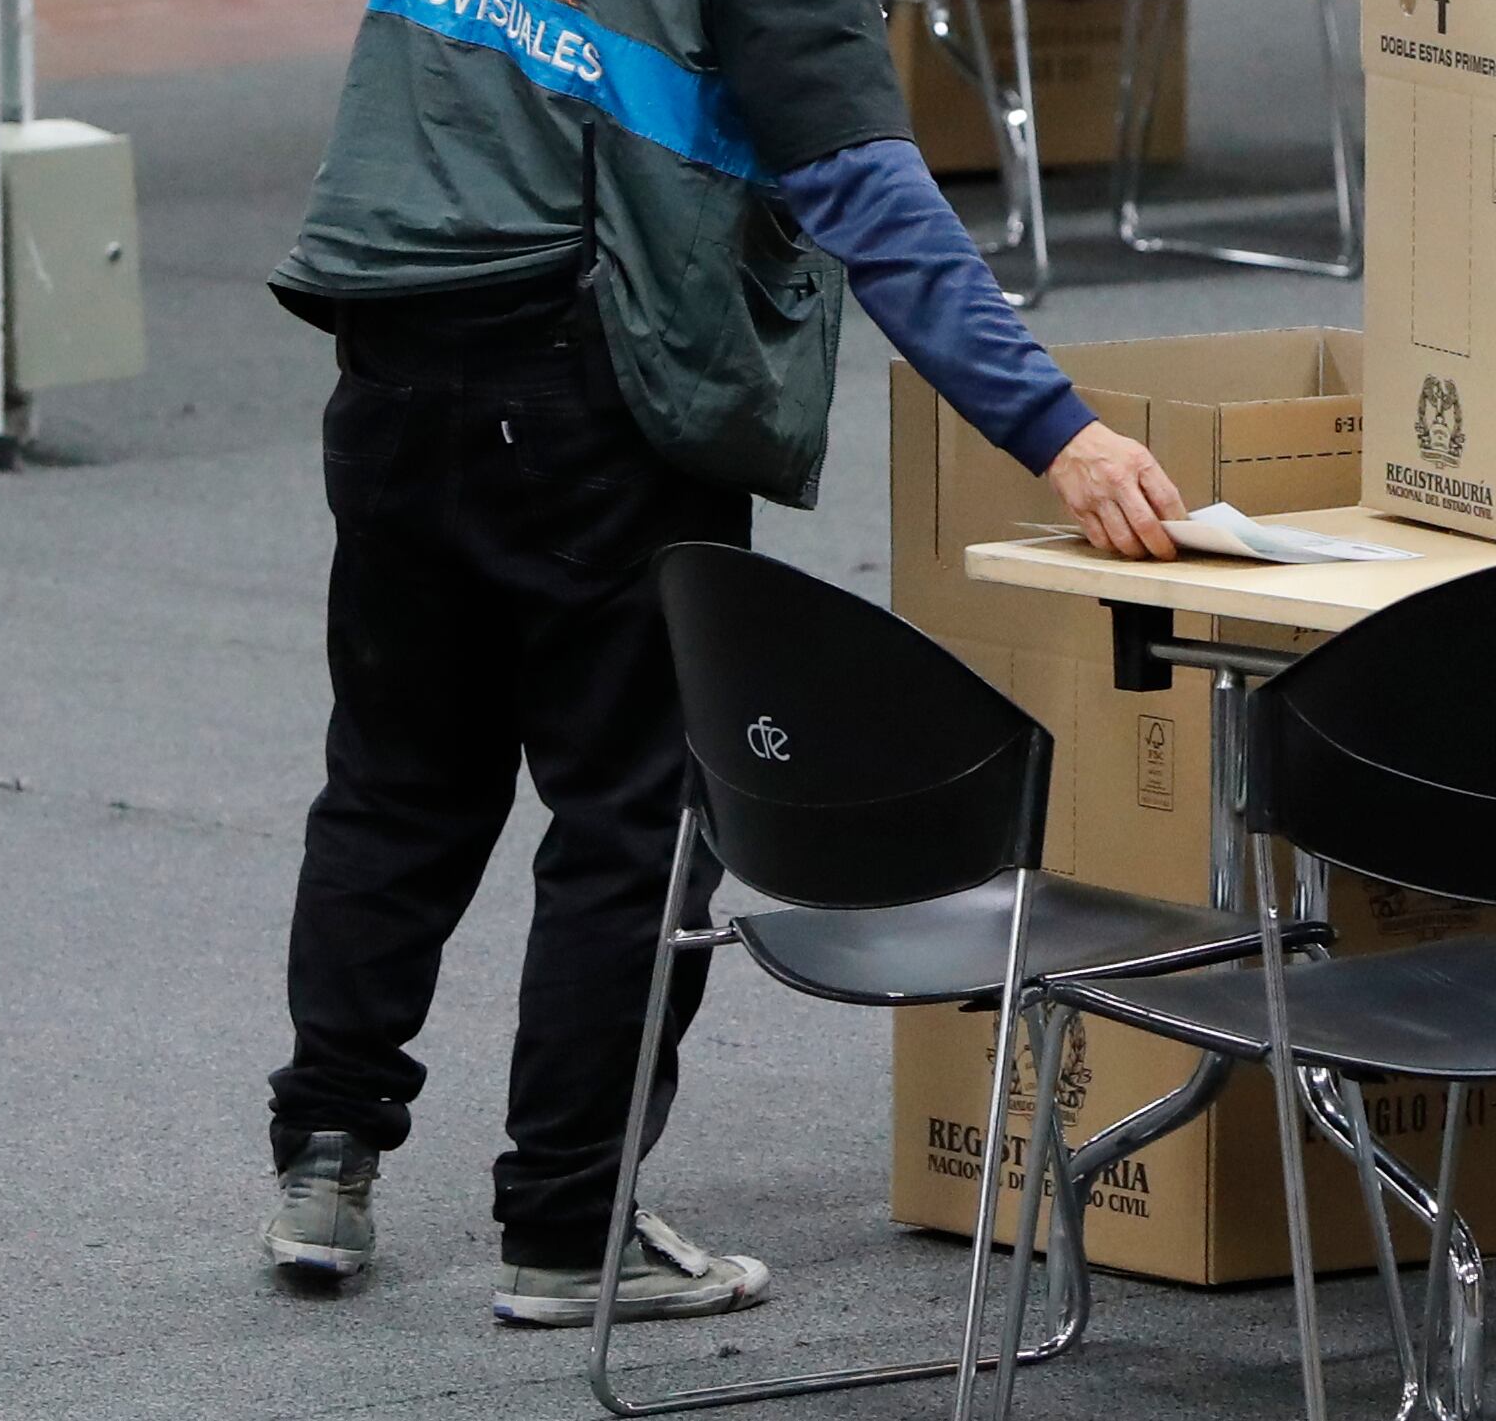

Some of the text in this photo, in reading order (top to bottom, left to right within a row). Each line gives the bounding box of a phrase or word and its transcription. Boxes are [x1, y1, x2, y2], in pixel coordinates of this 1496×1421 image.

[1381, 35, 1416, 59] DOBLE
[1419, 43, 1452, 67] ESTAS
[1335, 416, 1355, 432] E-9
[1386, 462, 1493, 506] REGISTRADURÍA
[1386, 483, 1493, 520] NACIONAL DEL ESTADO CIVIL
[1109, 1193, 1150, 1218] CIVIL
